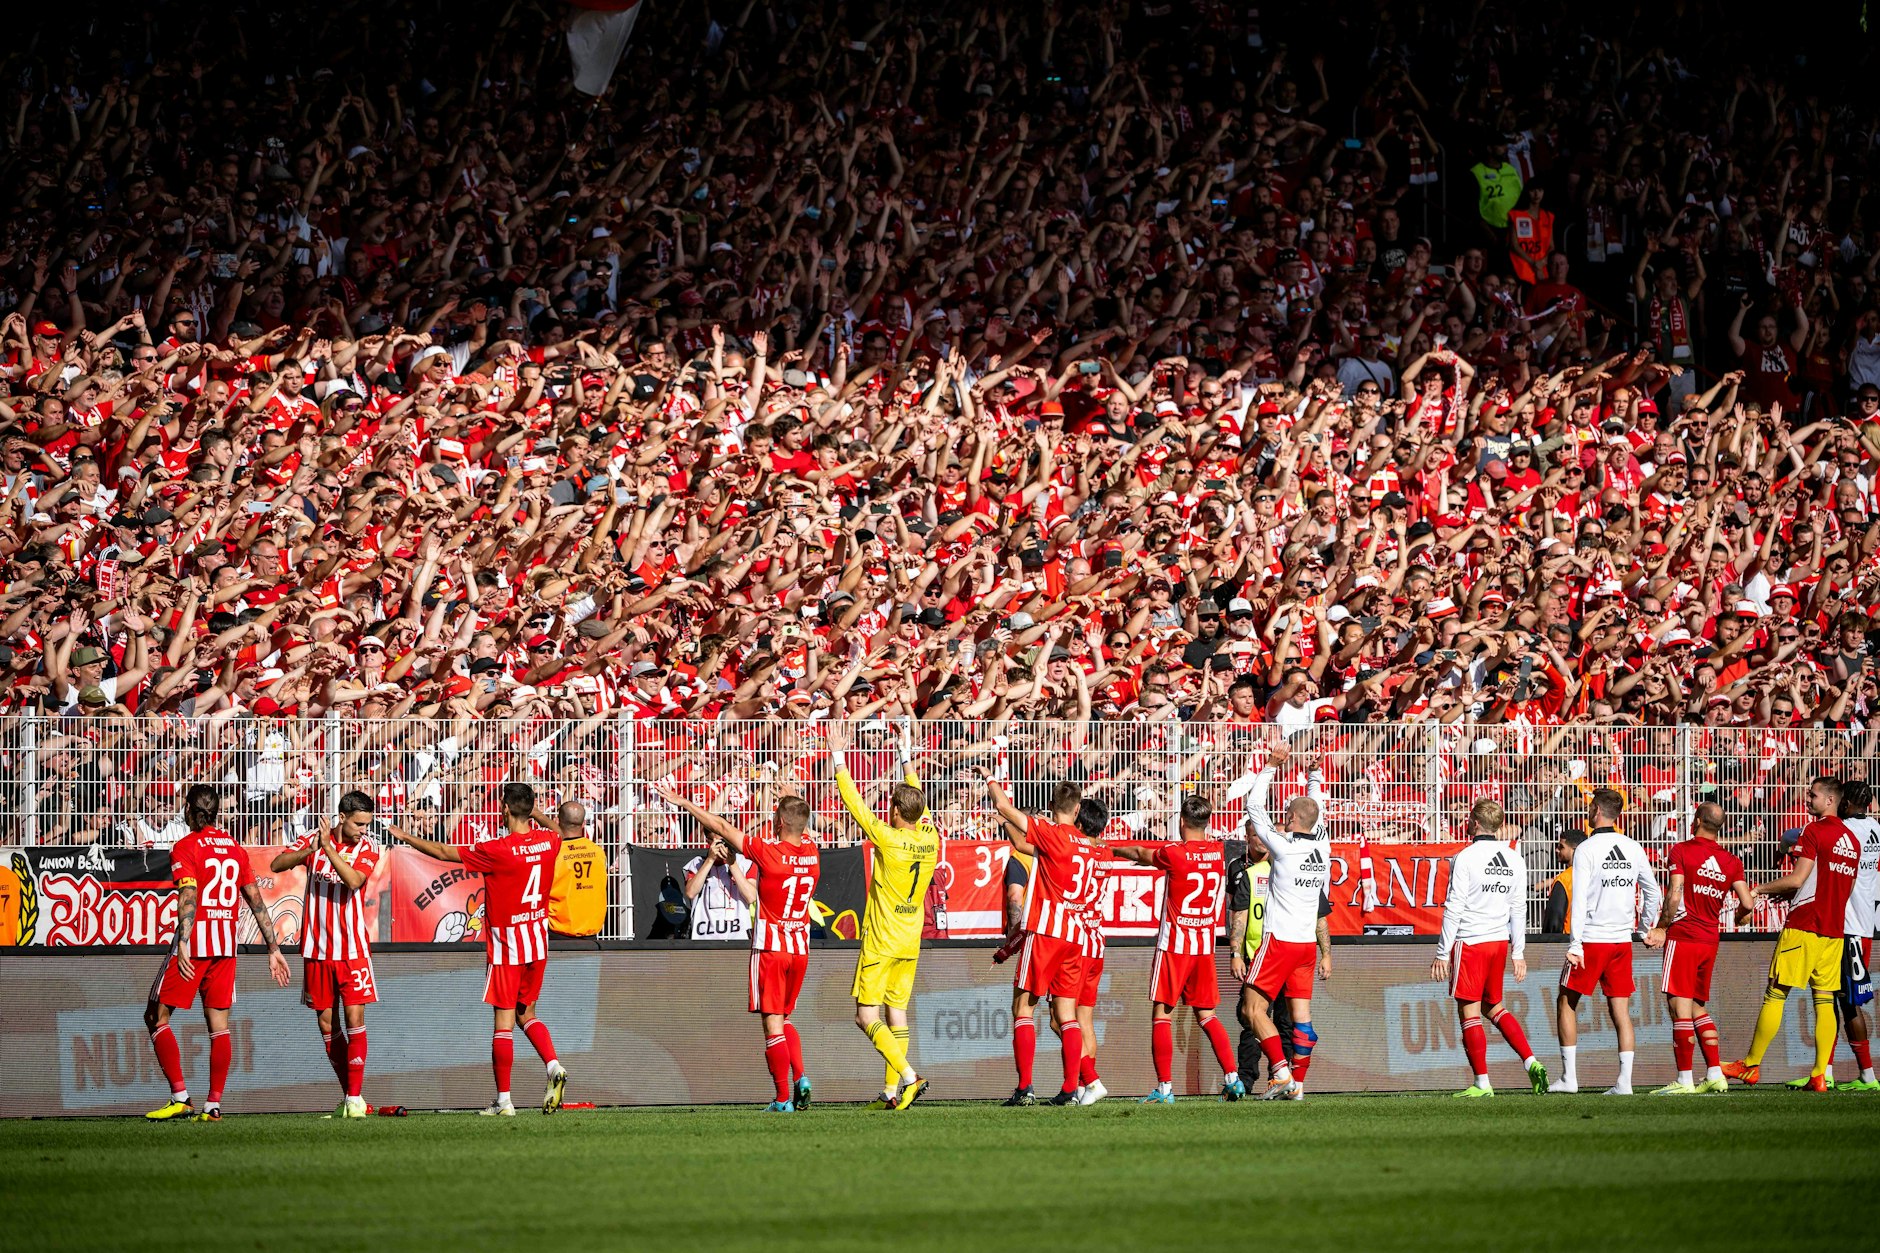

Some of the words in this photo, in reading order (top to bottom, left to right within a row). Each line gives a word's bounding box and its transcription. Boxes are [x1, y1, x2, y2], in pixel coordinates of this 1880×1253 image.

[1486, 184, 1504, 198] 22
[519, 845, 529, 855] FC
[528, 841, 552, 854] UNION
[916, 844, 935, 853] UNION
[1832, 845, 1858, 860] adidas
[39, 857, 74, 870] UNION
[789, 856, 798, 865] FC
[799, 855, 818, 866] UNION
[1193, 853, 1201, 862] FC
[1202, 852, 1222, 862] UNION
[573, 861, 593, 879] 97
[1299, 863, 1326, 872] adidas
[1484, 866, 1514, 877] adidas
[1602, 860, 1632, 870] adidas
[1828, 861, 1856, 877] wefox
[201, 858, 240, 908] 28
[908, 861, 921, 903] 1
[1063, 855, 1094, 900] 31
[1601, 876, 1634, 888] wefox
[1697, 868, 1727, 883] adidas
[521, 864, 543, 910] 4
[1181, 872, 1220, 915] 23
[1692, 883, 1725, 900] wefox
[781, 875, 815, 919] 13
[696, 918, 741, 936] CLUB
[350, 967, 372, 992] 32
[934, 1000, 1009, 1041] radio
